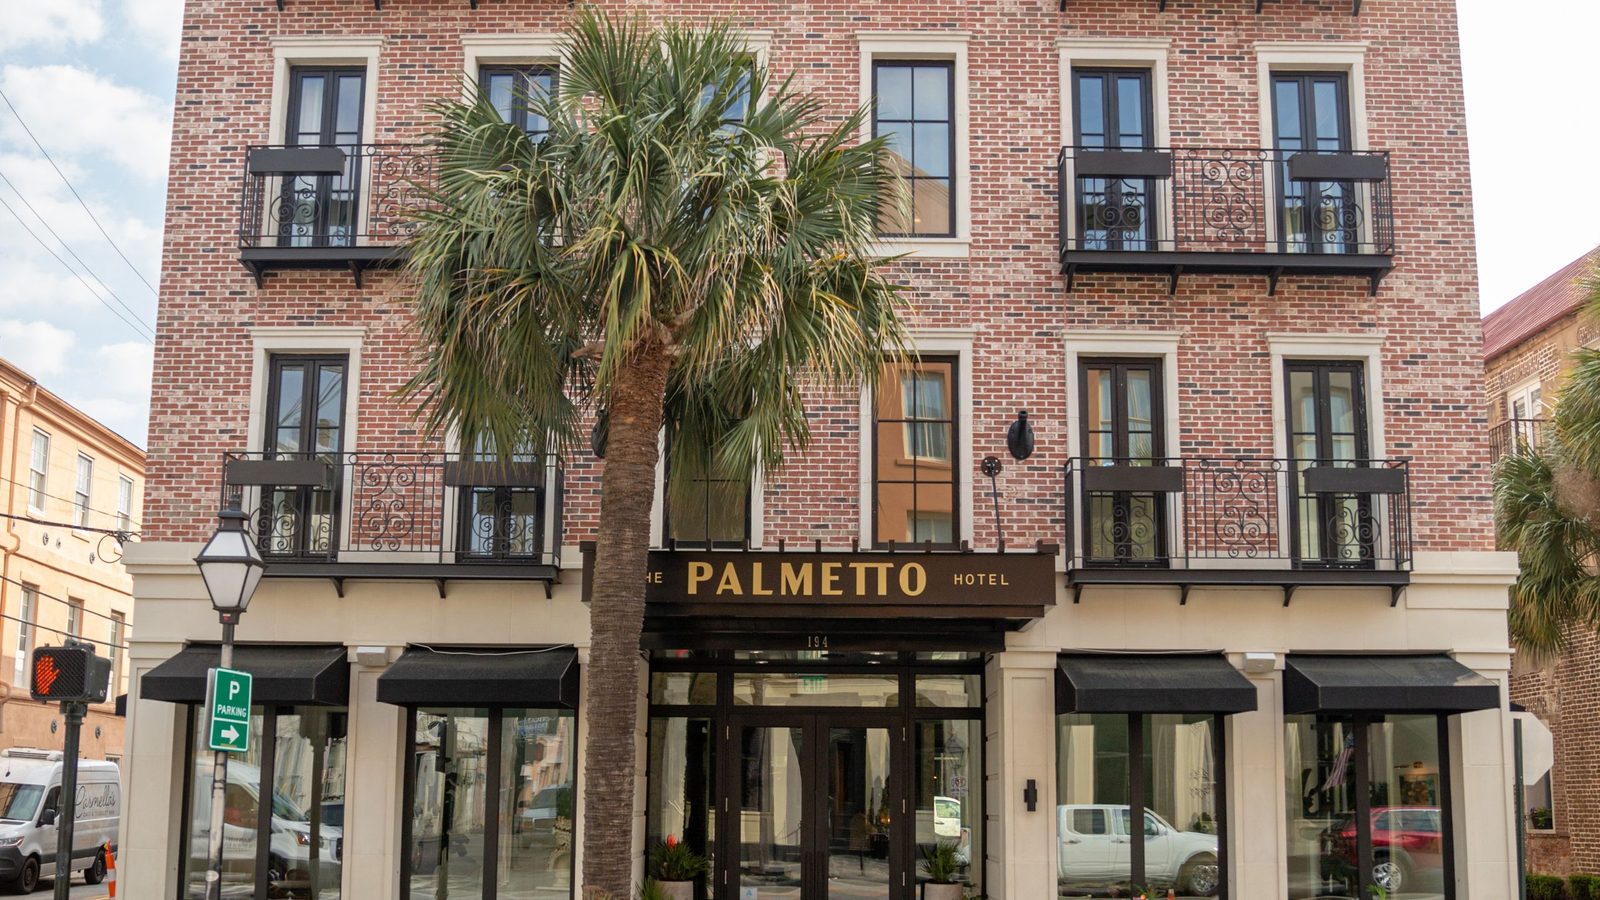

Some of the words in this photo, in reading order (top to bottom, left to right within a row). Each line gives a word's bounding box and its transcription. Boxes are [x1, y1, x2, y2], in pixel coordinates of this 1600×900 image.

[645, 572, 663, 583] HE
[687, 562, 927, 596] PALMETTO
[954, 573, 1009, 586] HOTEL
[808, 635, 828, 648] 194
[229, 680, 240, 700] P
[217, 704, 247, 718] PARKING
